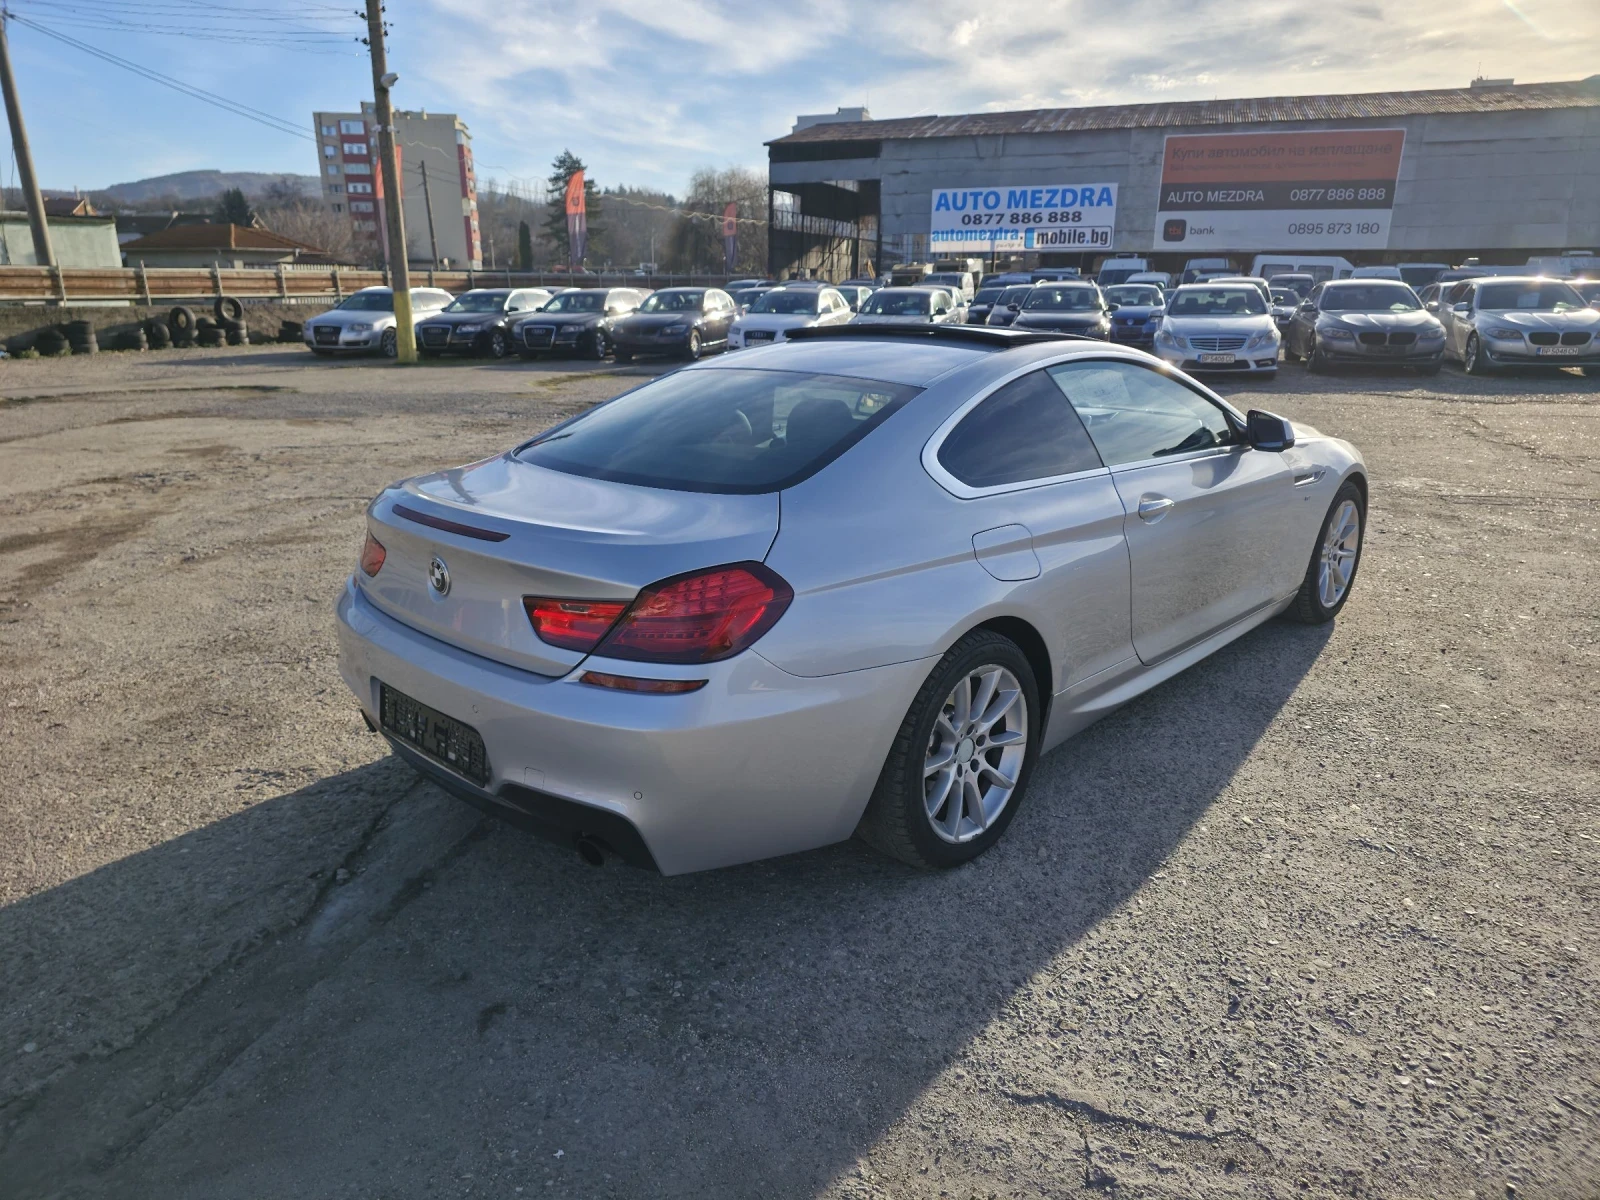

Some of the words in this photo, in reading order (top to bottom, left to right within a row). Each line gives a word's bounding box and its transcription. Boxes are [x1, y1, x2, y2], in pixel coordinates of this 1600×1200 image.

[1173, 148, 1204, 161] Купи
[1208, 145, 1285, 159] автомобил
[1288, 146, 1305, 156] на
[1309, 143, 1393, 156] изплащане
[935, 191, 1001, 211] AUTO
[1007, 187, 1113, 209] MEZDRA
[1167, 191, 1204, 203] AUTO
[1206, 190, 1265, 202] MEZDRA
[1290, 189, 1325, 201] 0877
[1327, 188, 1354, 201] 886
[1357, 188, 1386, 200] 888
[961, 213, 1005, 226] 0877
[1009, 212, 1043, 225] 886
[1048, 211, 1083, 223] 888
[1189, 226, 1215, 236] bank
[1288, 223, 1323, 235] 0895
[1327, 222, 1352, 235] 873
[1355, 222, 1380, 235] 180
[1036, 229, 1109, 246] mobile.bg
